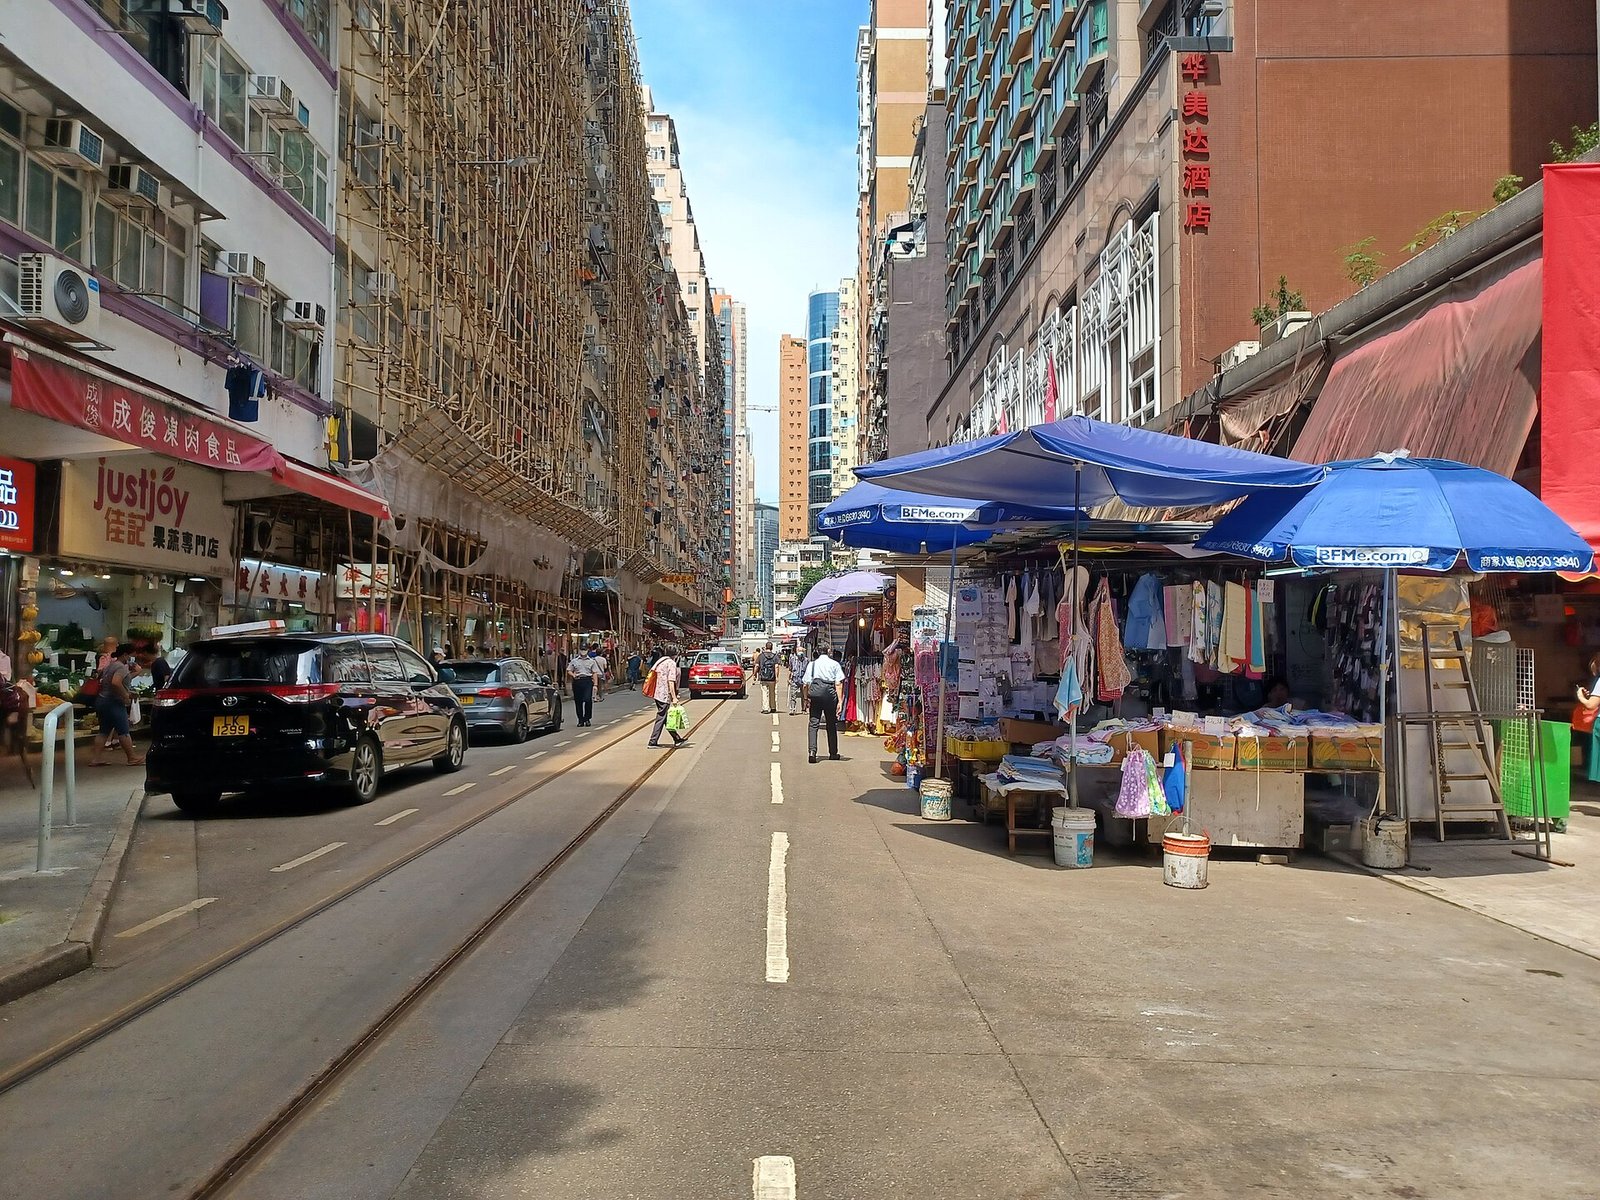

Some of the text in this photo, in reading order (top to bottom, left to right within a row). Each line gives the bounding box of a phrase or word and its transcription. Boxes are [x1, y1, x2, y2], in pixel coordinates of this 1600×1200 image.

[1183, 54, 1211, 227] 华美达酒店
[112, 398, 242, 466] 成俊凍肉食品
[94, 457, 190, 528] justjoy
[902, 507, 964, 519] BFMe.com
[104, 507, 146, 547] 佳記
[153, 525, 219, 559] 果蔬專門店
[1319, 549, 1407, 561] BFMe.com
[1524, 556, 1551, 568] 6930
[1553, 556, 1580, 568] 3940
[217, 725, 246, 735] 1299
[224, 715, 240, 726] LK
